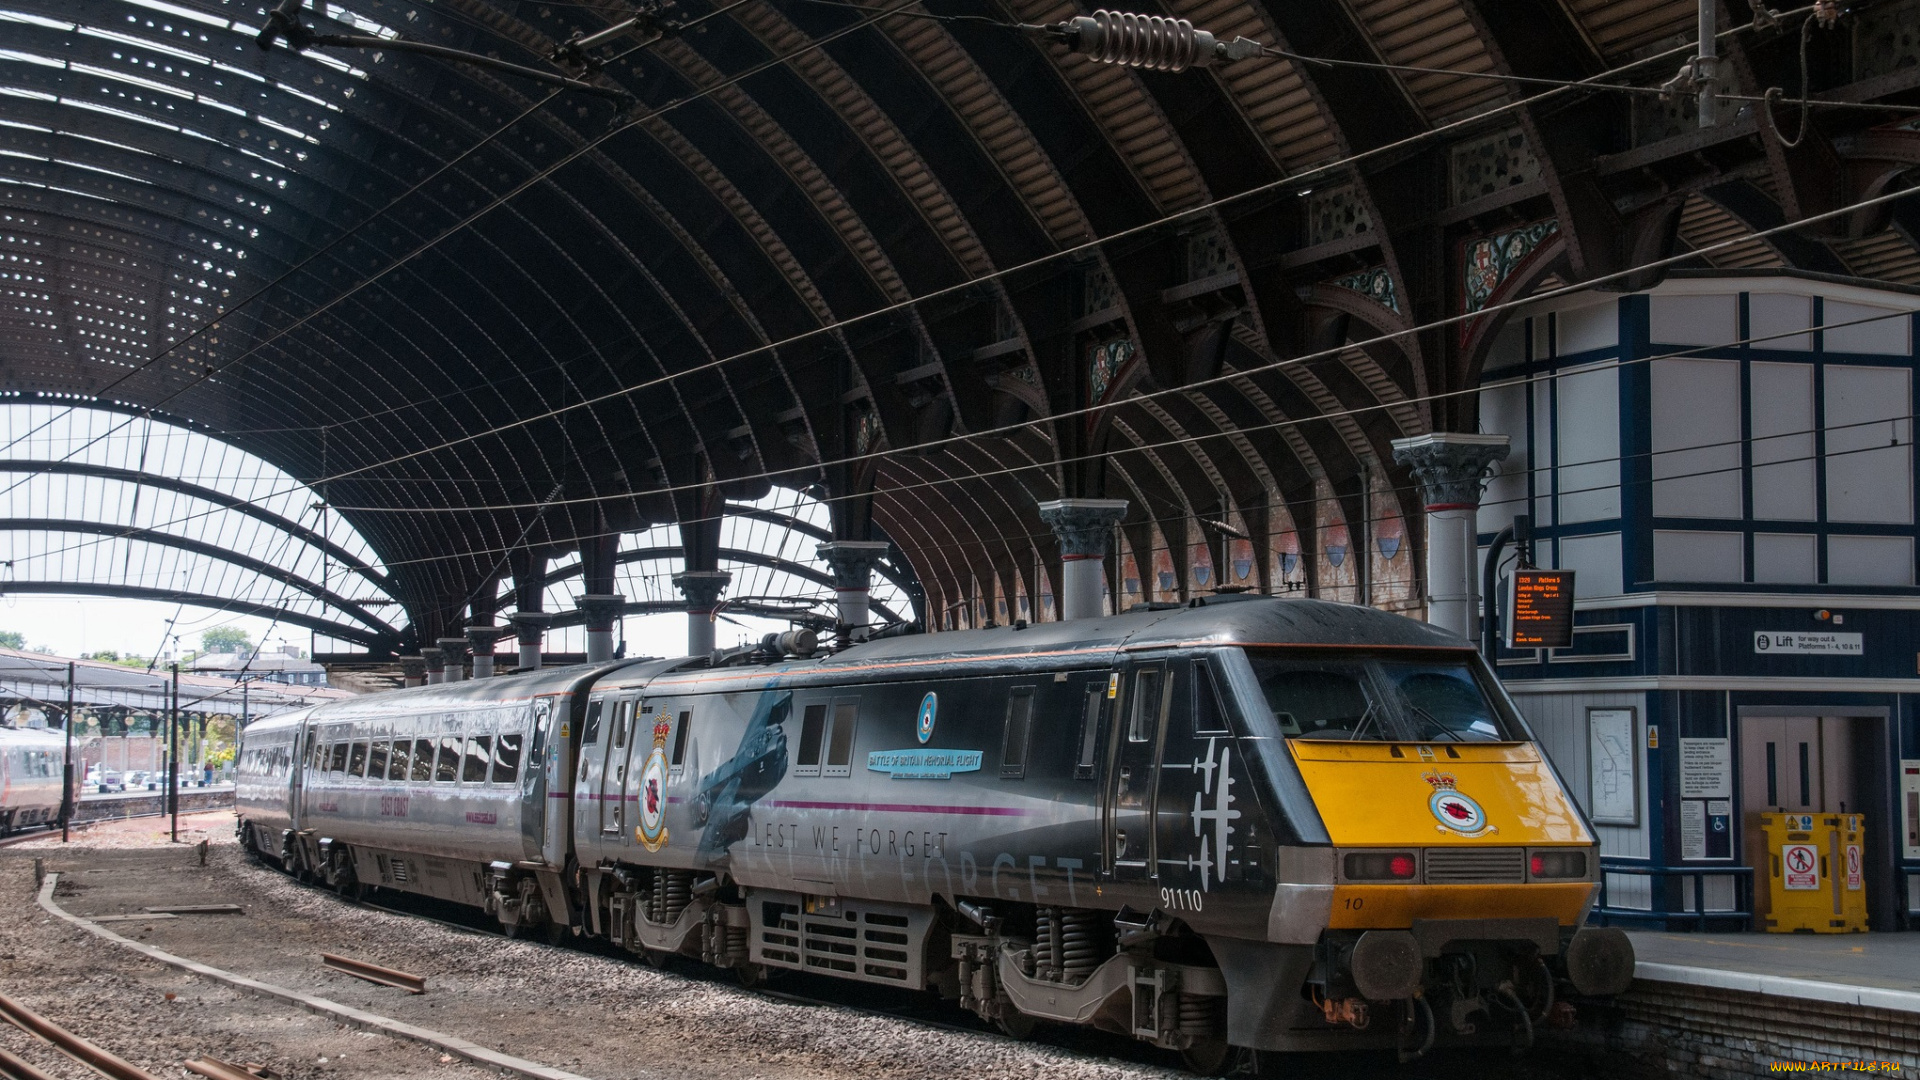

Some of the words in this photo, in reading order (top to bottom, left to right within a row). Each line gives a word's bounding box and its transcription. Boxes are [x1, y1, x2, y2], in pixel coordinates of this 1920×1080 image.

[1776, 636, 1793, 647] Lift
[869, 755, 890, 766] BATTLE
[891, 755, 899, 766] OF
[900, 755, 923, 766] BRITAIN
[924, 755, 954, 766] MEMORIAL
[956, 755, 979, 767] FLIGHT
[755, 823, 797, 848] LEST
[813, 826, 839, 851] WE
[857, 828, 948, 858] FORGET
[900, 846, 1083, 909] FORGET
[1161, 887, 1202, 912] 91110
[1345, 897, 1363, 910] 10
